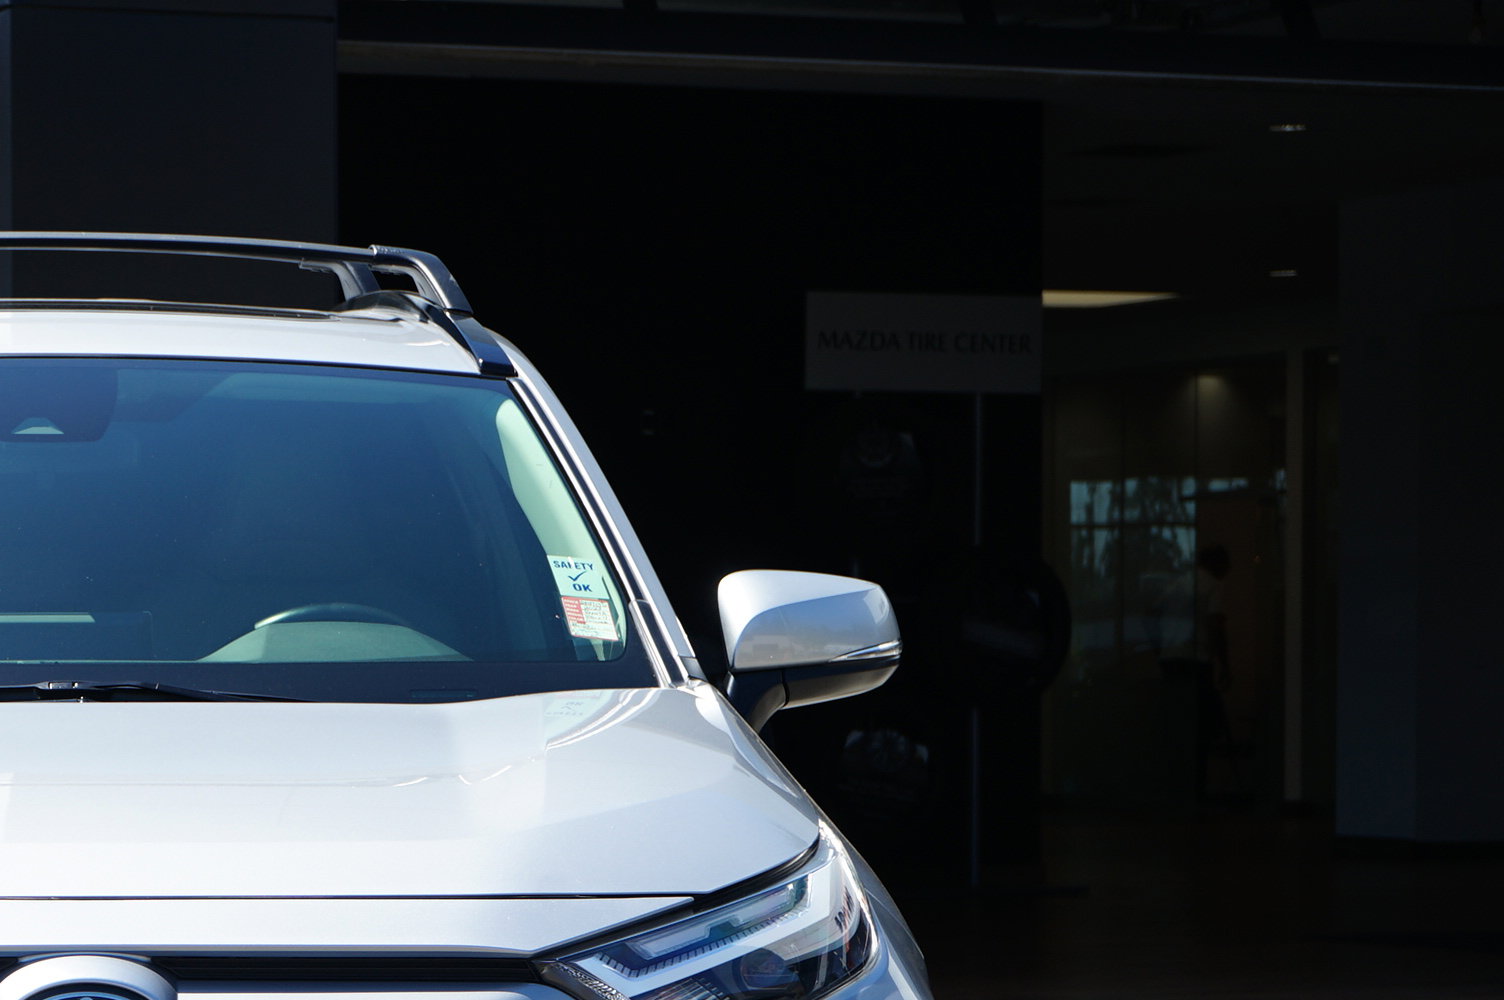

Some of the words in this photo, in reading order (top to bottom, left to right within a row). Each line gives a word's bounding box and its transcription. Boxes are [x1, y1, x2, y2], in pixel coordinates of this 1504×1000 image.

[817, 330, 901, 352] MAZDA
[908, 331, 945, 353] TIRE
[953, 332, 1032, 355] CENTER
[572, 583, 593, 592] OK
